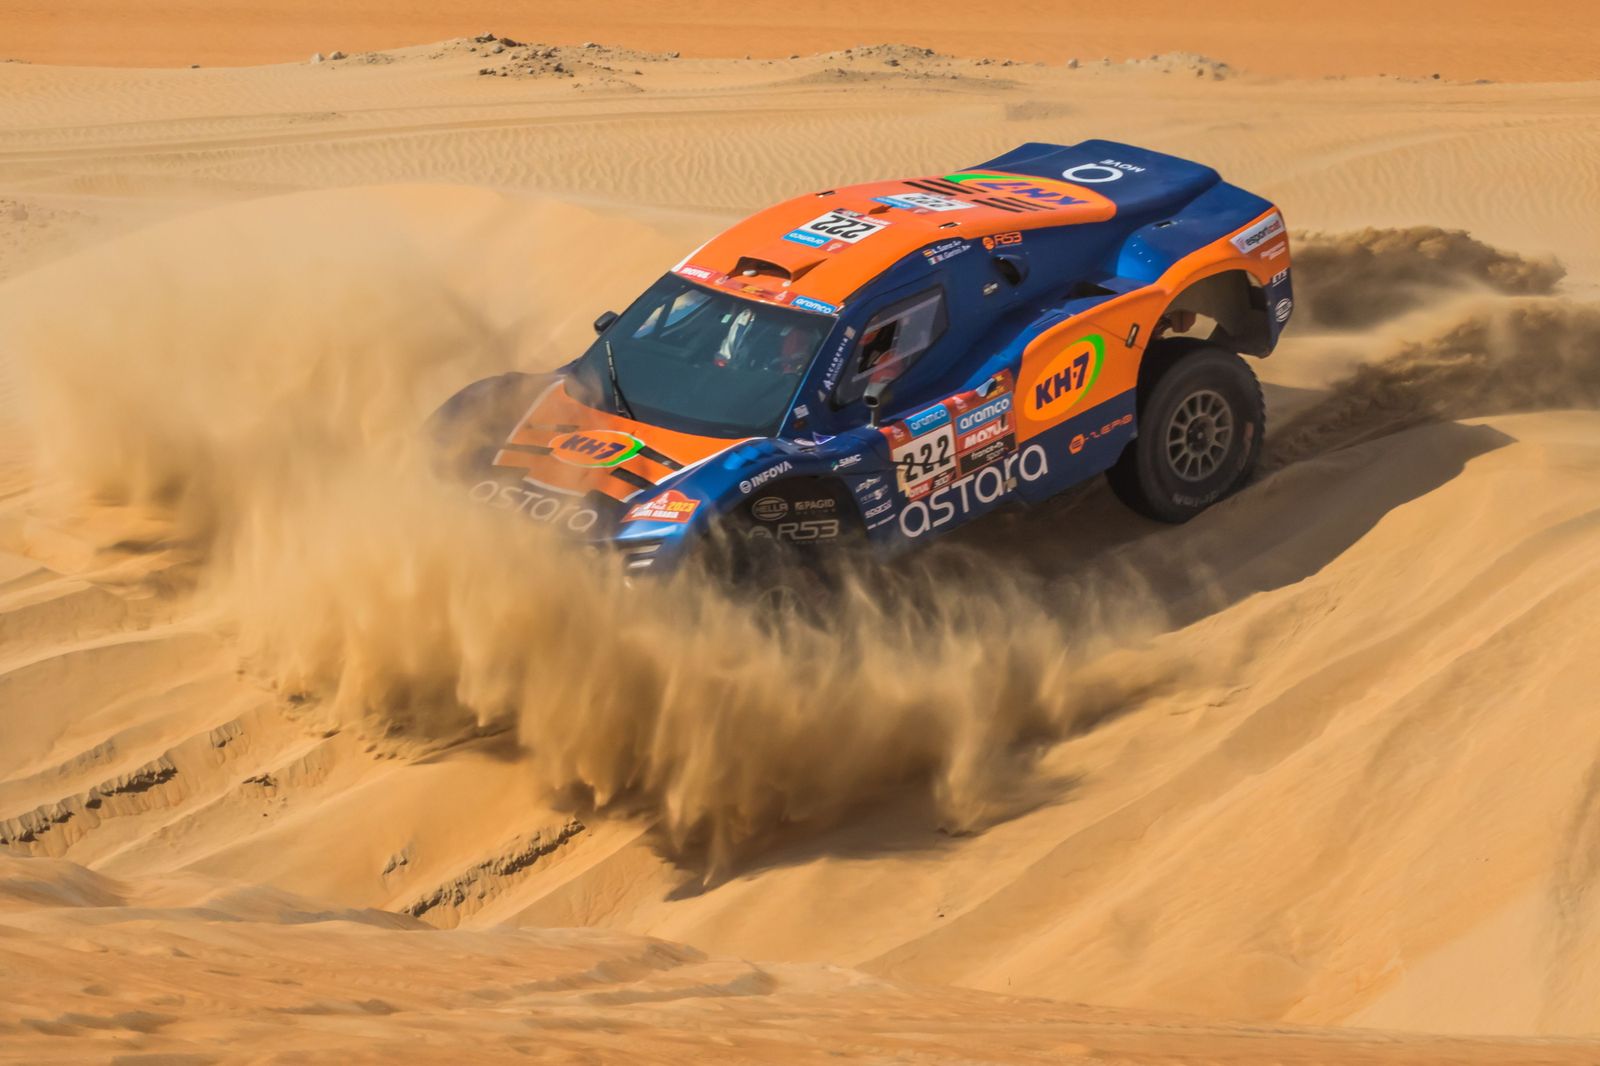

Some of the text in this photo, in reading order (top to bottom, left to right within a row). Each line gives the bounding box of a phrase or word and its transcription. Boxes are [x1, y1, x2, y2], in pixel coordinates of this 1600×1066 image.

[1099, 158, 1146, 173] MOVE
[788, 232, 826, 245] aramco
[809, 214, 877, 240] 222
[679, 267, 712, 279] MOTUL
[796, 298, 832, 314] aramco
[910, 409, 947, 431] aramco
[960, 398, 1010, 430] aramco
[964, 415, 1009, 449] MOTUL
[902, 435, 949, 482] 222
[751, 461, 793, 488] INFOVA
[899, 444, 1049, 538] astara
[467, 480, 599, 533] astara
[667, 502, 696, 513] 2023
[805, 499, 836, 511] PAGID
